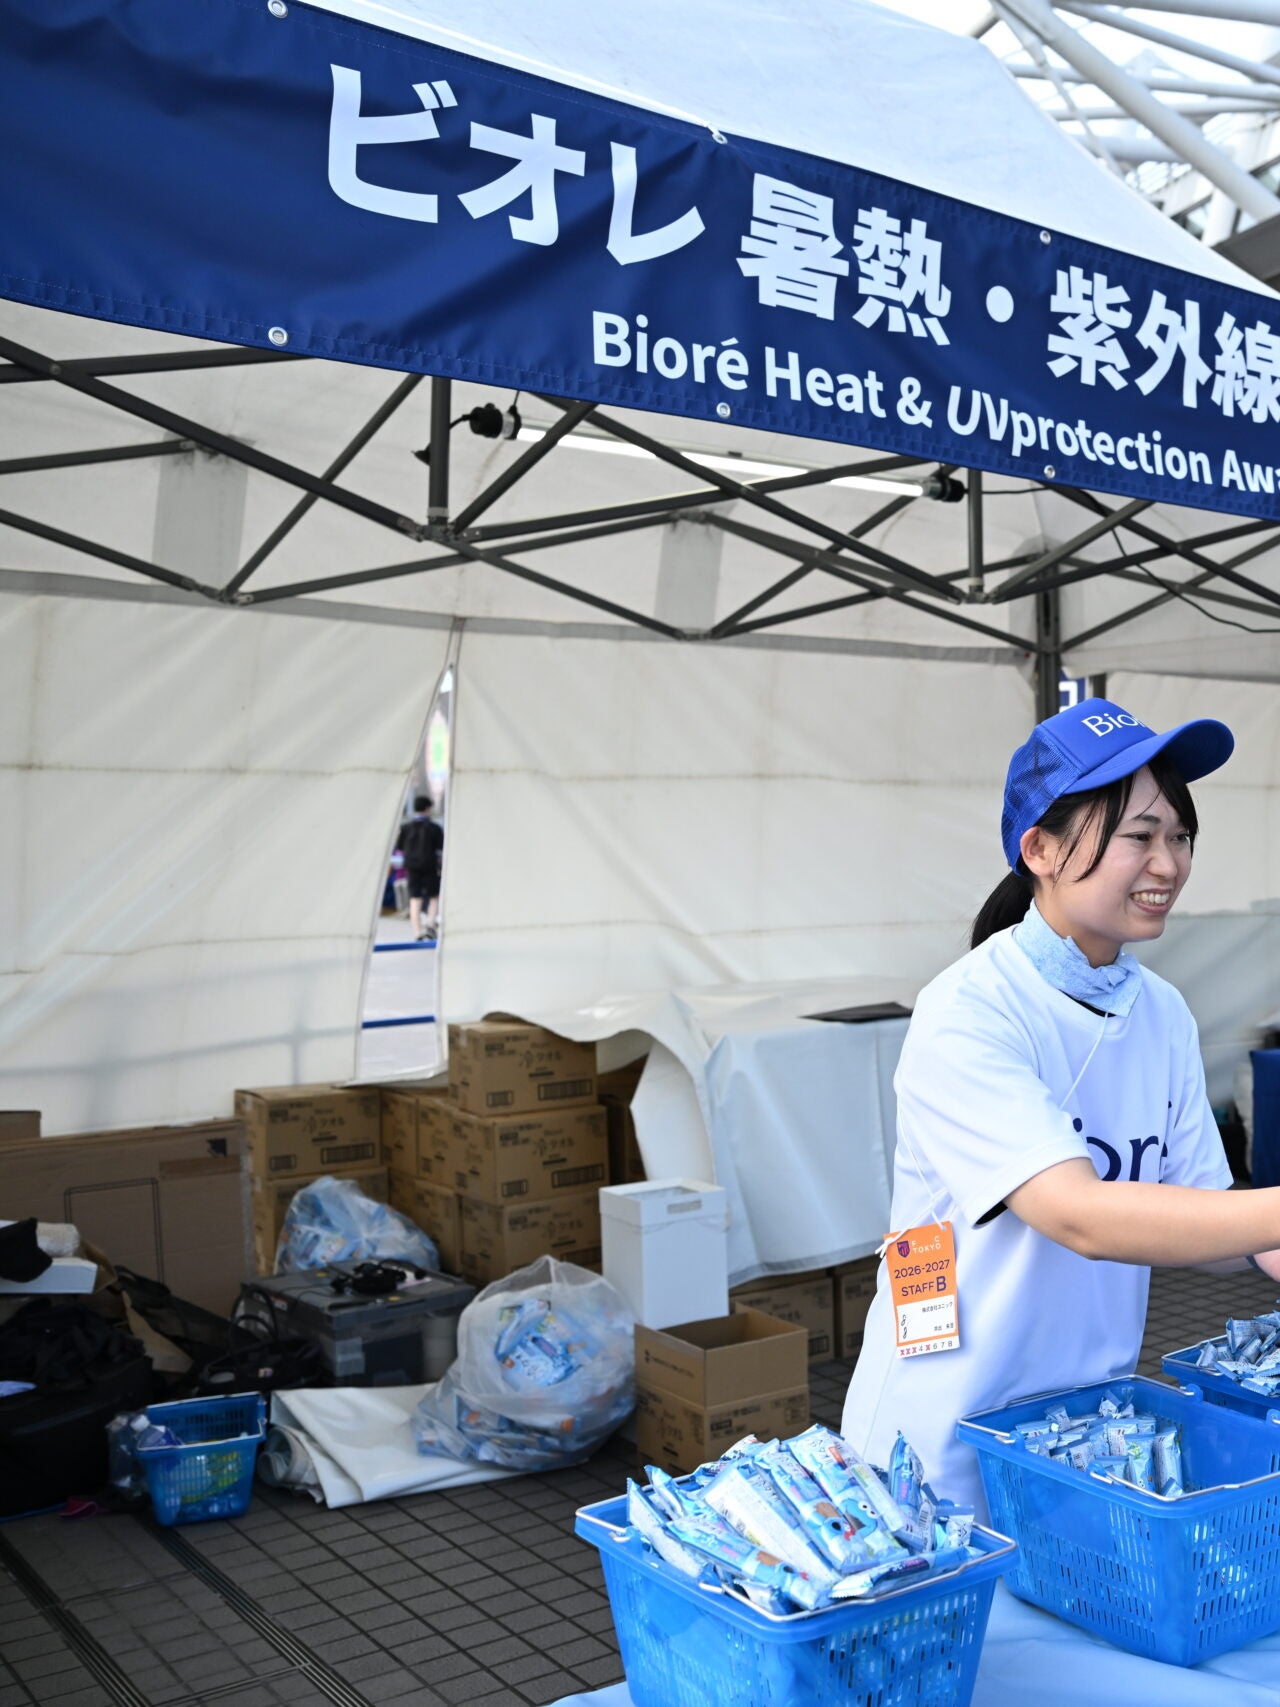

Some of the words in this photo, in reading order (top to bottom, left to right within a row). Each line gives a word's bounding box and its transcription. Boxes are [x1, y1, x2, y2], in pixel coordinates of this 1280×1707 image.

[328, 63, 706, 265] ビオレ
[592, 310, 750, 391] Bioré
[764, 346, 887, 419] Heat
[896, 377, 934, 428] &
[912, 1243, 941, 1254] TOKYO
[894, 1259, 950, 1279] 2026-2027
[901, 1281, 935, 1297] STAFF
[936, 1276, 947, 1292] B
